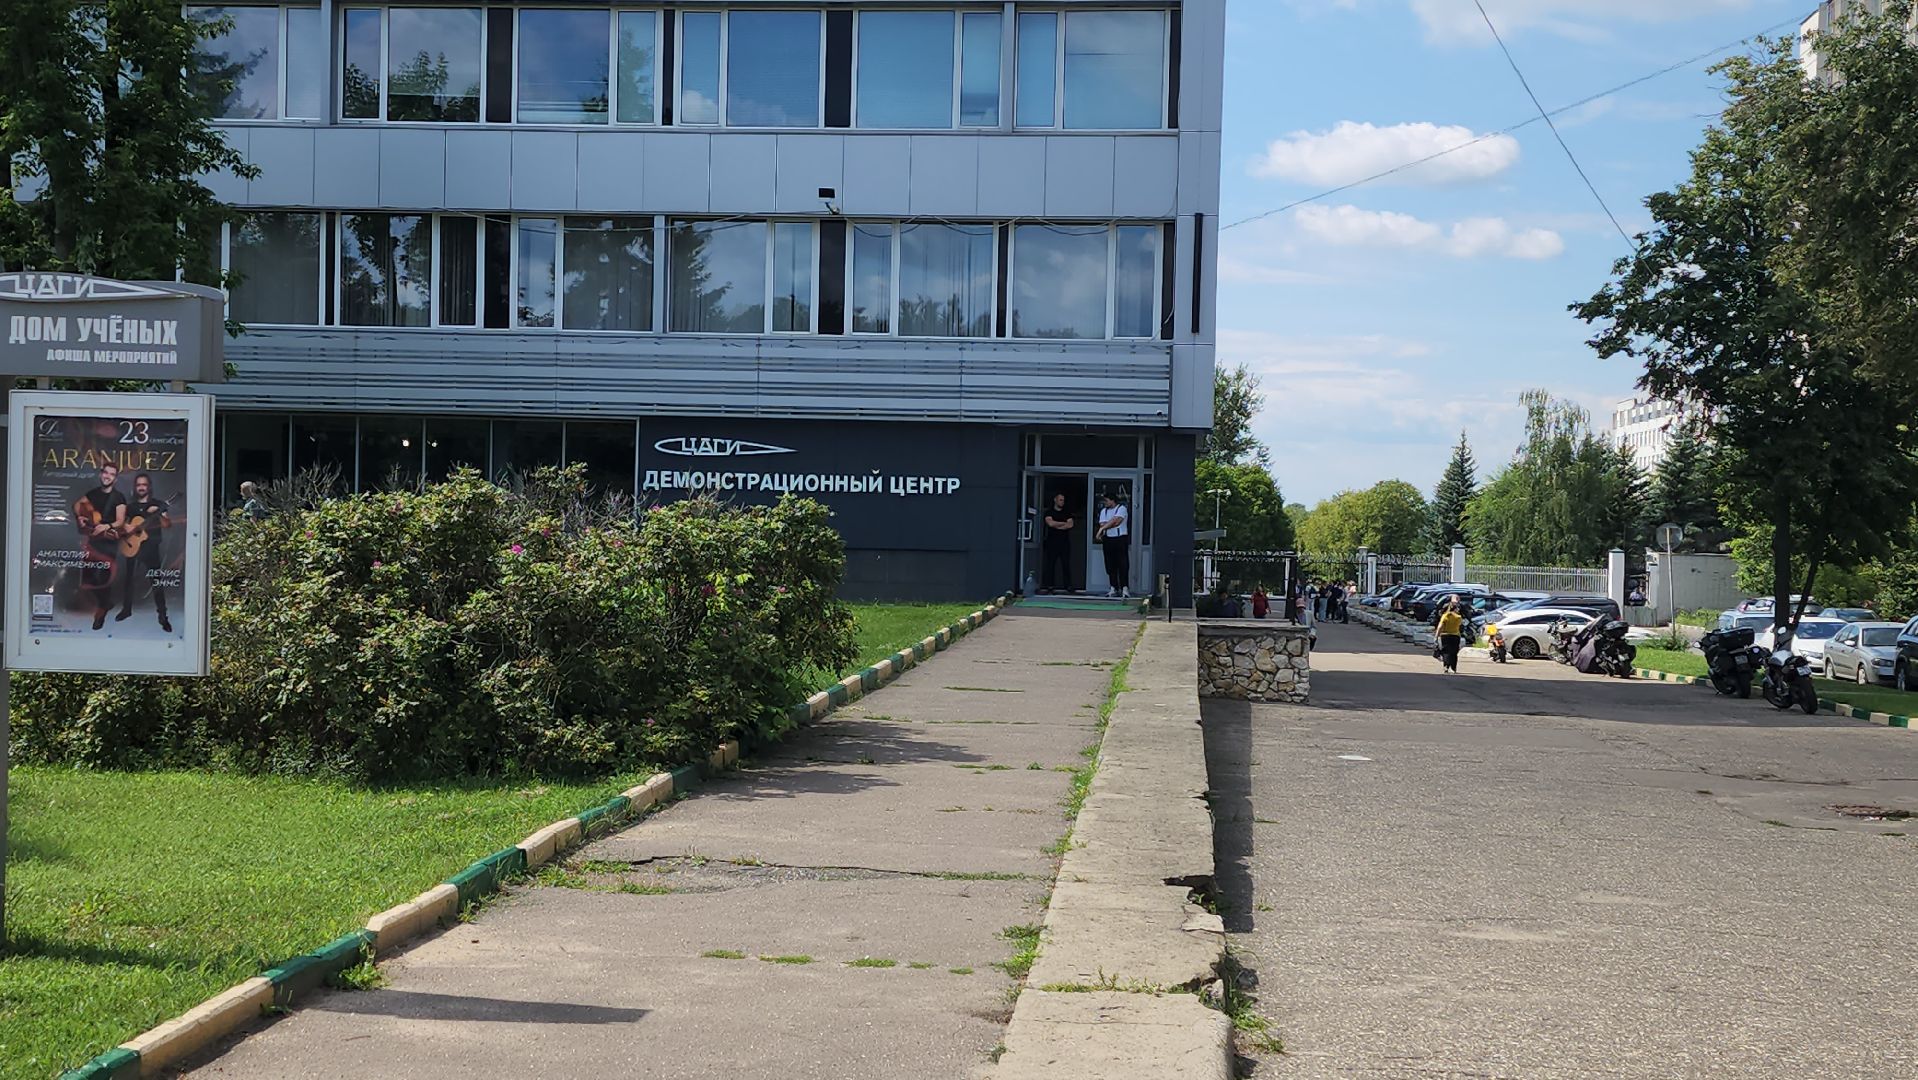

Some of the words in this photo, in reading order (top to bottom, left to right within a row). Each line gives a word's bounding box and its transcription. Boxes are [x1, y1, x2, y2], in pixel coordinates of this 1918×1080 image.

[14, 274, 95, 298] ЦАГИ
[9, 315, 67, 344] ДОМ
[77, 315, 178, 345] УЧЁНЫХ
[46, 349, 91, 362] АФИША
[93, 350, 177, 364] МЕРОПРИЯТИЙ
[119, 421, 149, 444] 23
[681, 437, 741, 456] ЦАГИ
[43, 448, 176, 472] ARANJUEZ
[642, 469, 883, 494] ДЕМОНСТРАЦИОННЫЙ
[890, 476, 961, 496] ЦЕНТР
[145, 568, 181, 577] ДЕНИС
